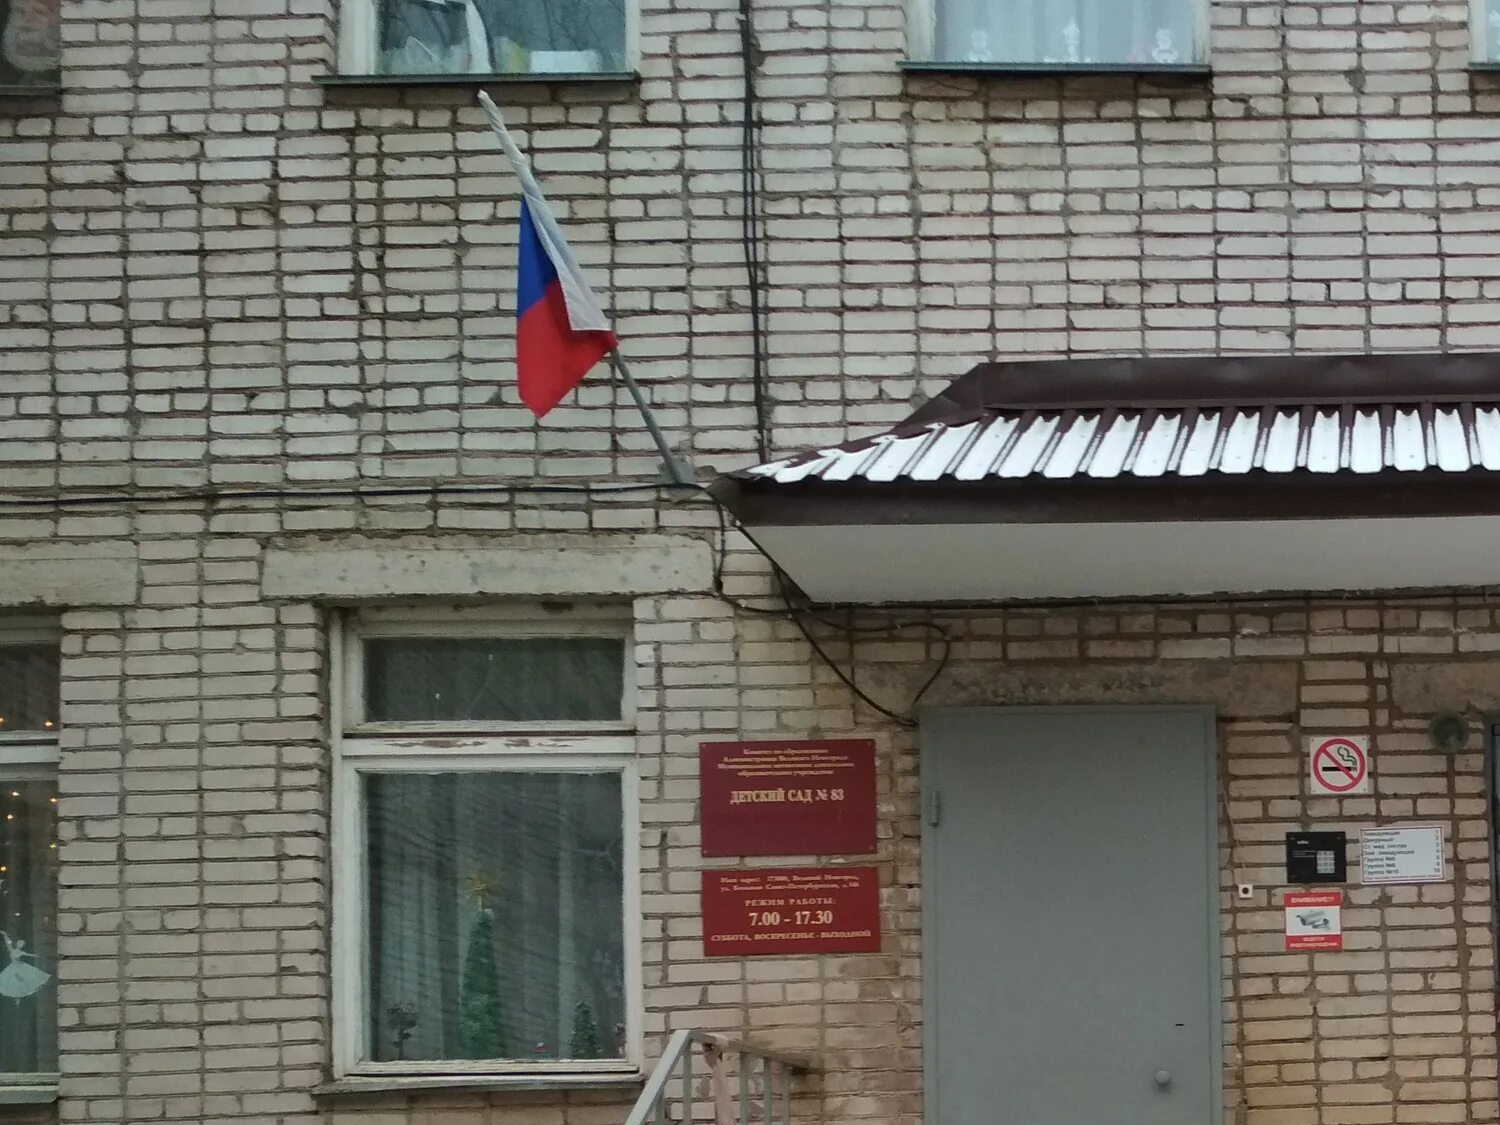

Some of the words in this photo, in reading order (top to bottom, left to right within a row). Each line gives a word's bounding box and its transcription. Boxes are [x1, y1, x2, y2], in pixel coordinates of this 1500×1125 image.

[730, 787, 785, 804] ДЕТСКИЙ
[787, 789, 813, 803] САД
[815, 789, 828, 801] №
[830, 788, 845, 801] 83
[744, 898, 785, 907] РЕЖИМ
[789, 897, 836, 906] РАБОТЫ:
[748, 911, 781, 926] 7.00
[795, 910, 833, 925] 17.30
